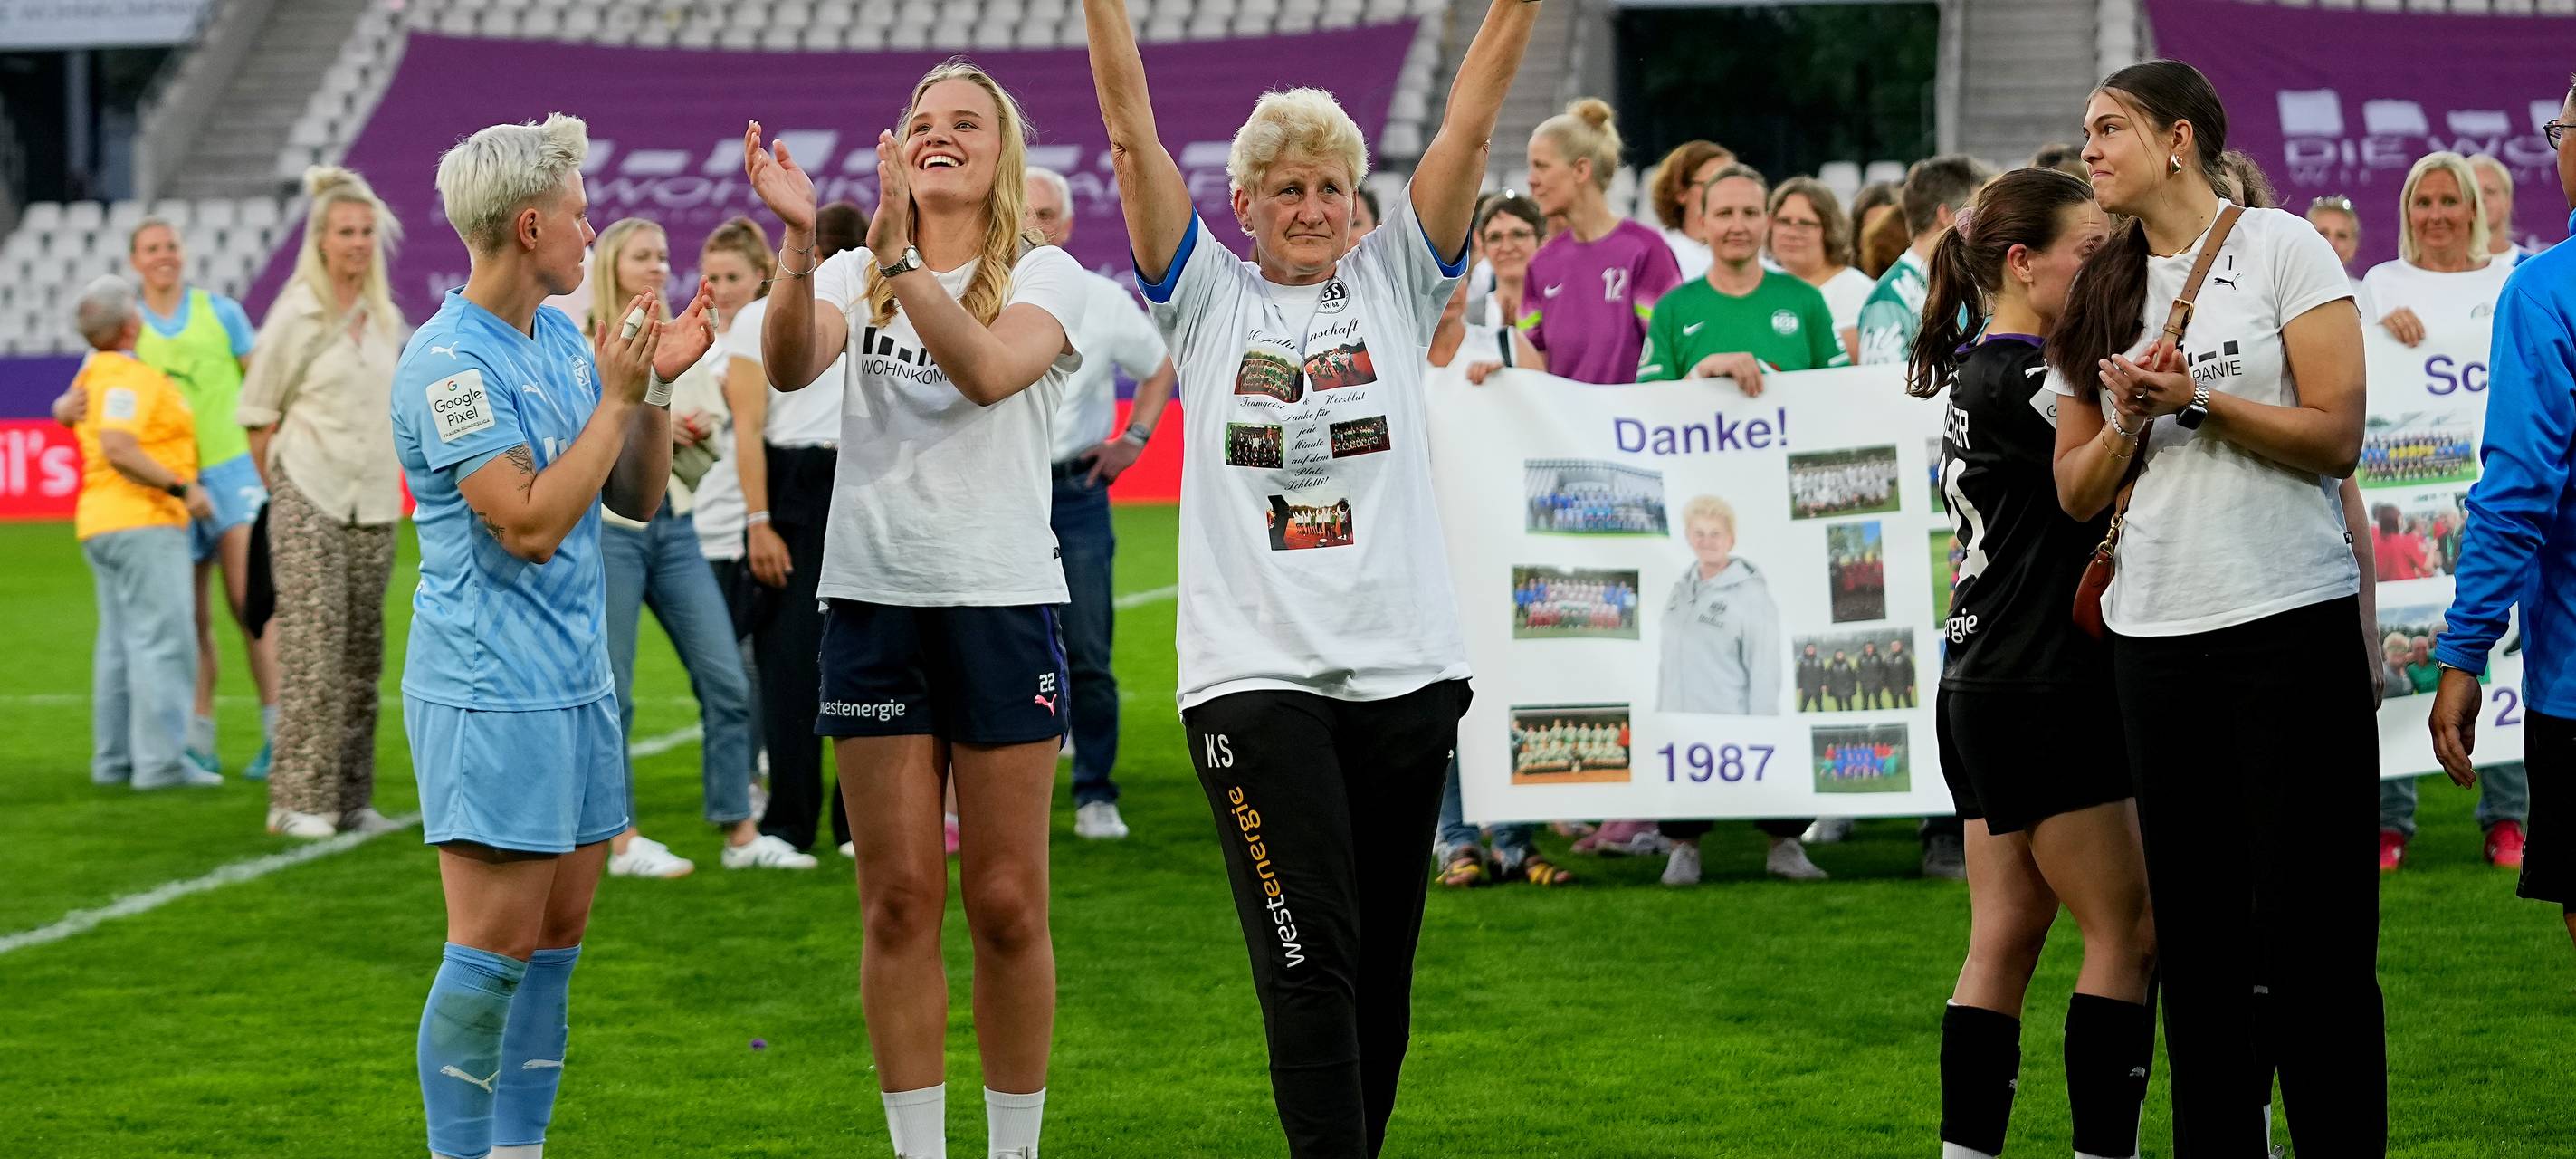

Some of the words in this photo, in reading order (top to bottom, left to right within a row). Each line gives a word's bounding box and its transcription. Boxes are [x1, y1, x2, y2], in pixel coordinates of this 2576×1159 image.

[1600, 267, 1628, 302] 12
[2424, 354, 2488, 395] Sc
[434, 388, 482, 414] Google
[446, 406, 479, 427] Pixel
[1291, 438, 1324, 451] Minute
[1295, 424, 1317, 439] jede
[1614, 407, 1788, 455] Danke!
[1038, 672, 1055, 693] 22
[2492, 686, 2521, 727] 2
[1204, 733, 1235, 768] KS
[1657, 741, 1775, 782] 1987
[1228, 785, 1305, 969] westenergie
